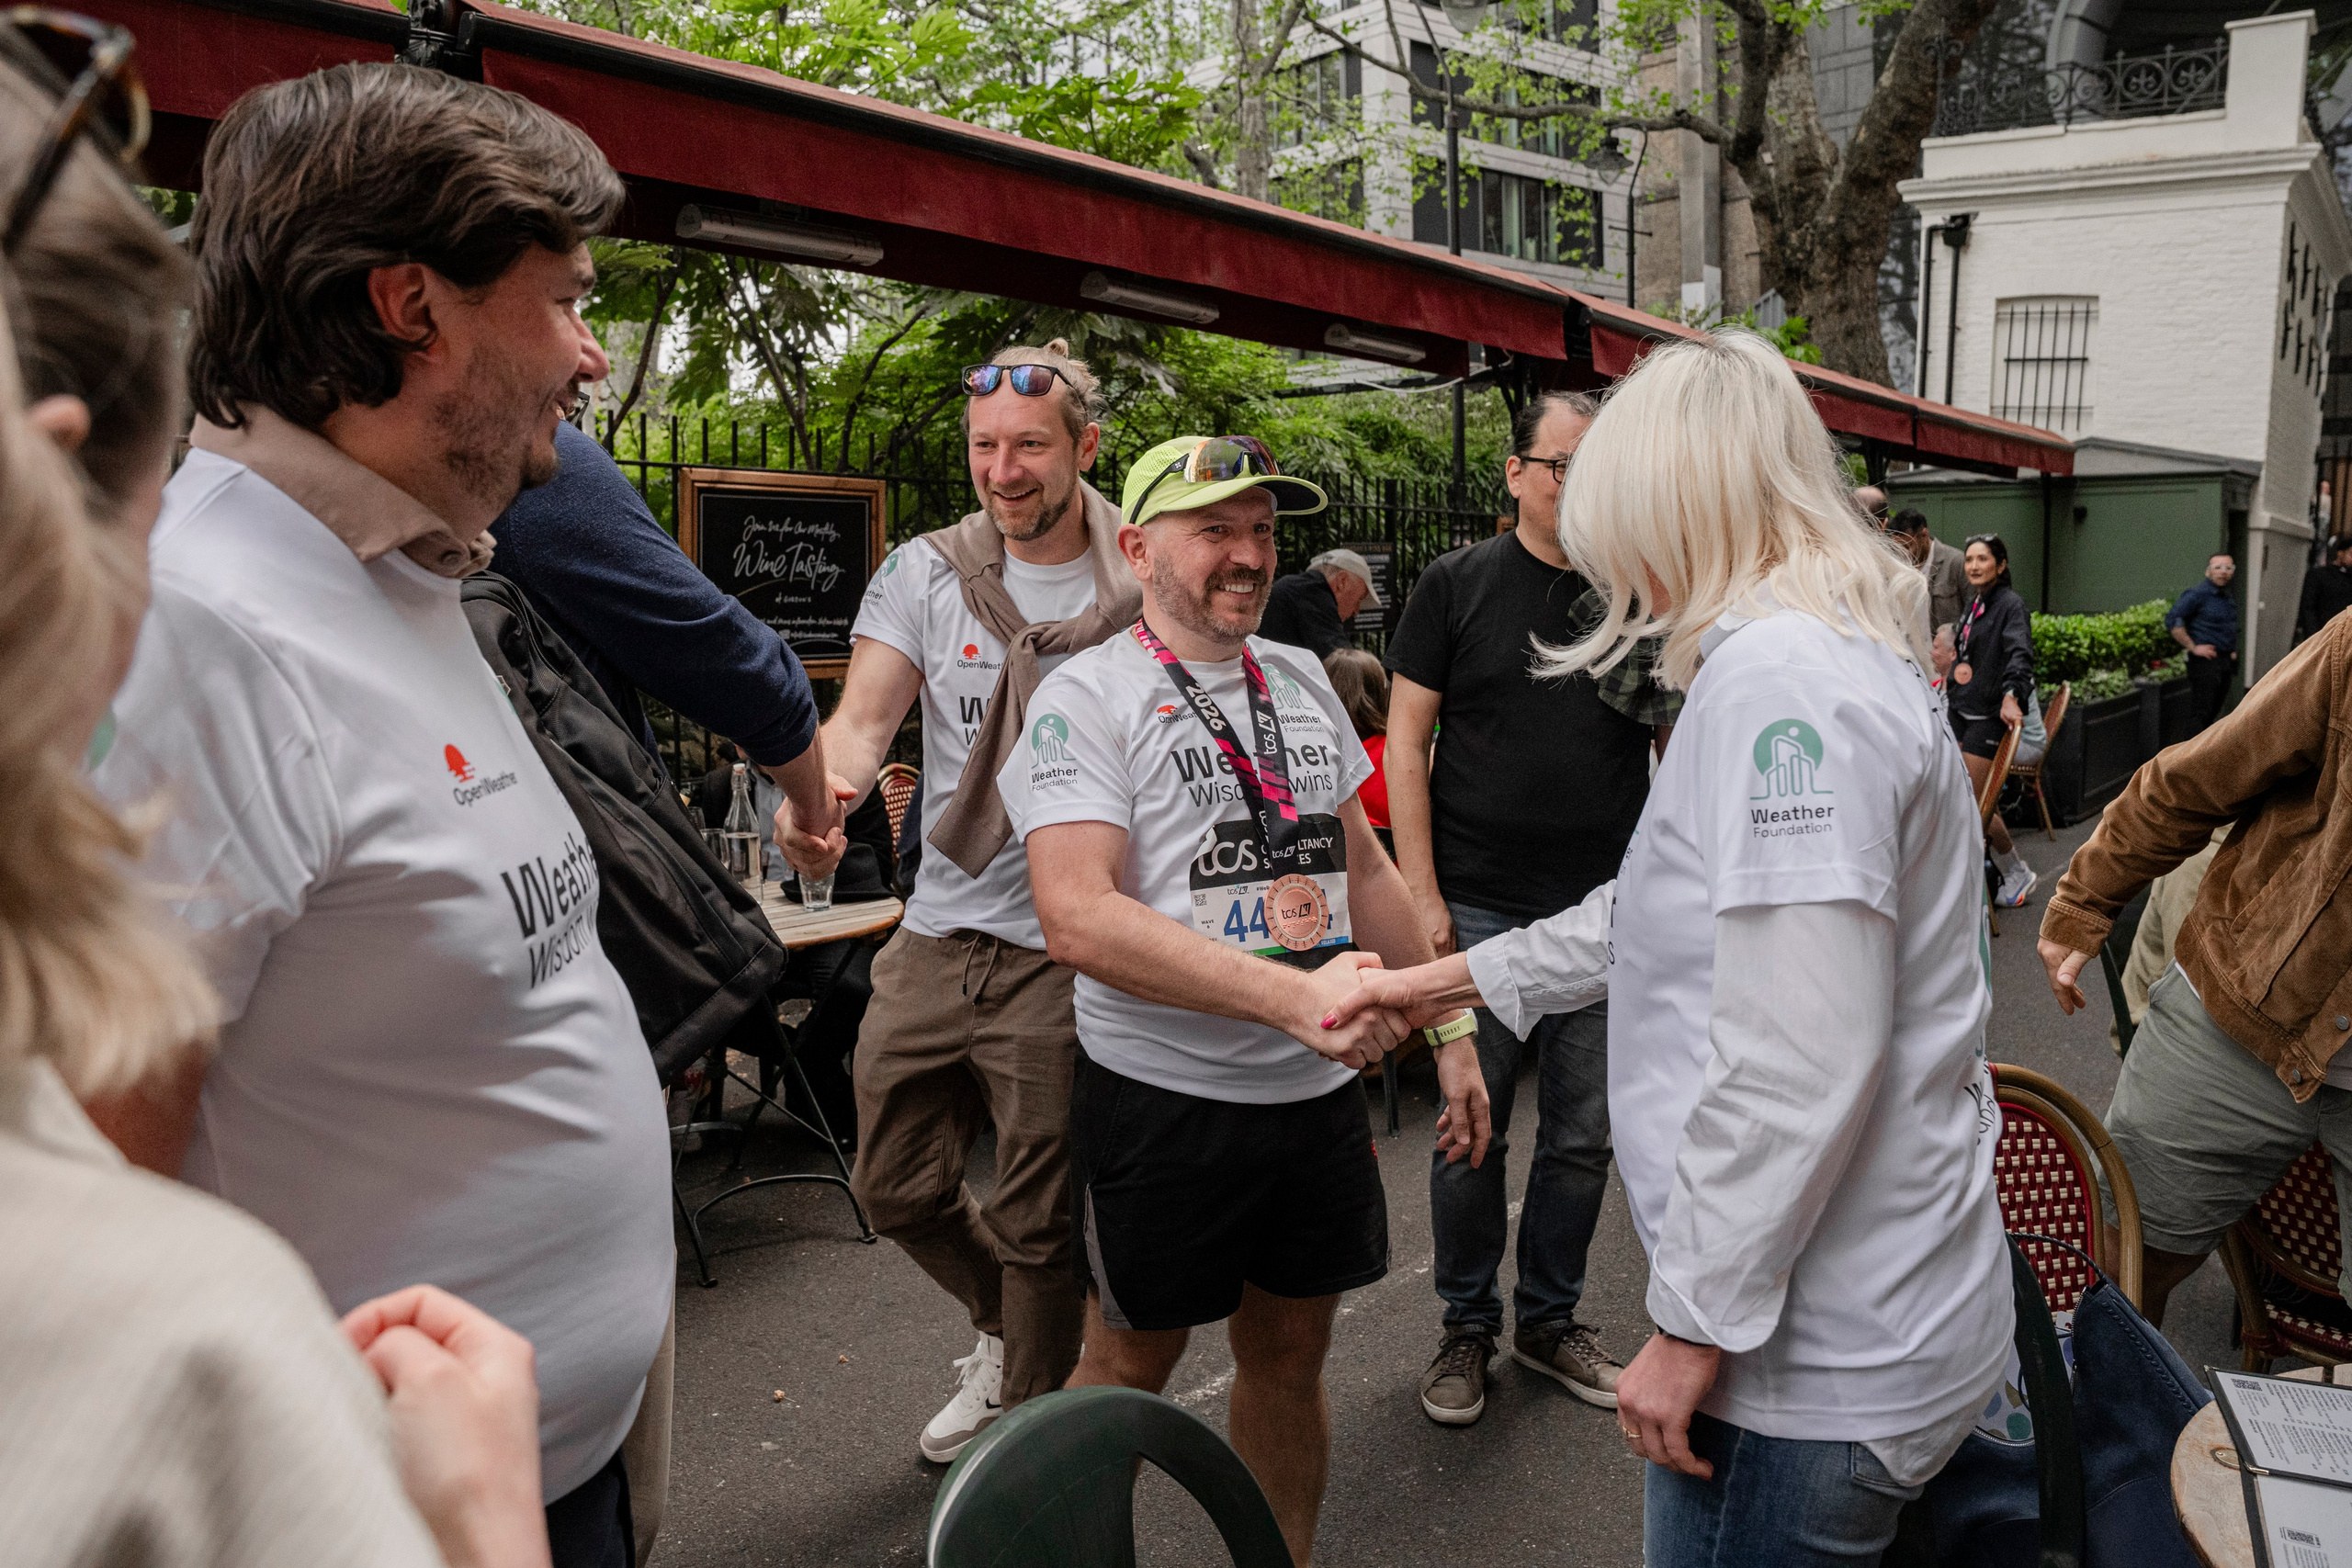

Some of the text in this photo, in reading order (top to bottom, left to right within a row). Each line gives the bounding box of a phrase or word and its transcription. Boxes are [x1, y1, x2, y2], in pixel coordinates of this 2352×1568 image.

[742, 514, 767, 542] Join
[732, 539, 846, 592] Wine Tasting
[956, 660, 1003, 671] OpenWeat
[1185, 682, 1227, 731] 2026
[1277, 713, 1321, 724] Weather
[1283, 725, 1324, 733] Foundation
[1263, 733, 1278, 755] tcs
[1031, 767, 1079, 784] Weather
[1032, 778, 1078, 792] Foundation
[1288, 770, 1333, 794] wins
[1750, 805, 1835, 824] Weather
[1753, 823, 1832, 838] Foundation
[500, 831, 598, 938] Weathe
[1281, 908, 1297, 919] tcs
[529, 914, 588, 989] Wisdom
